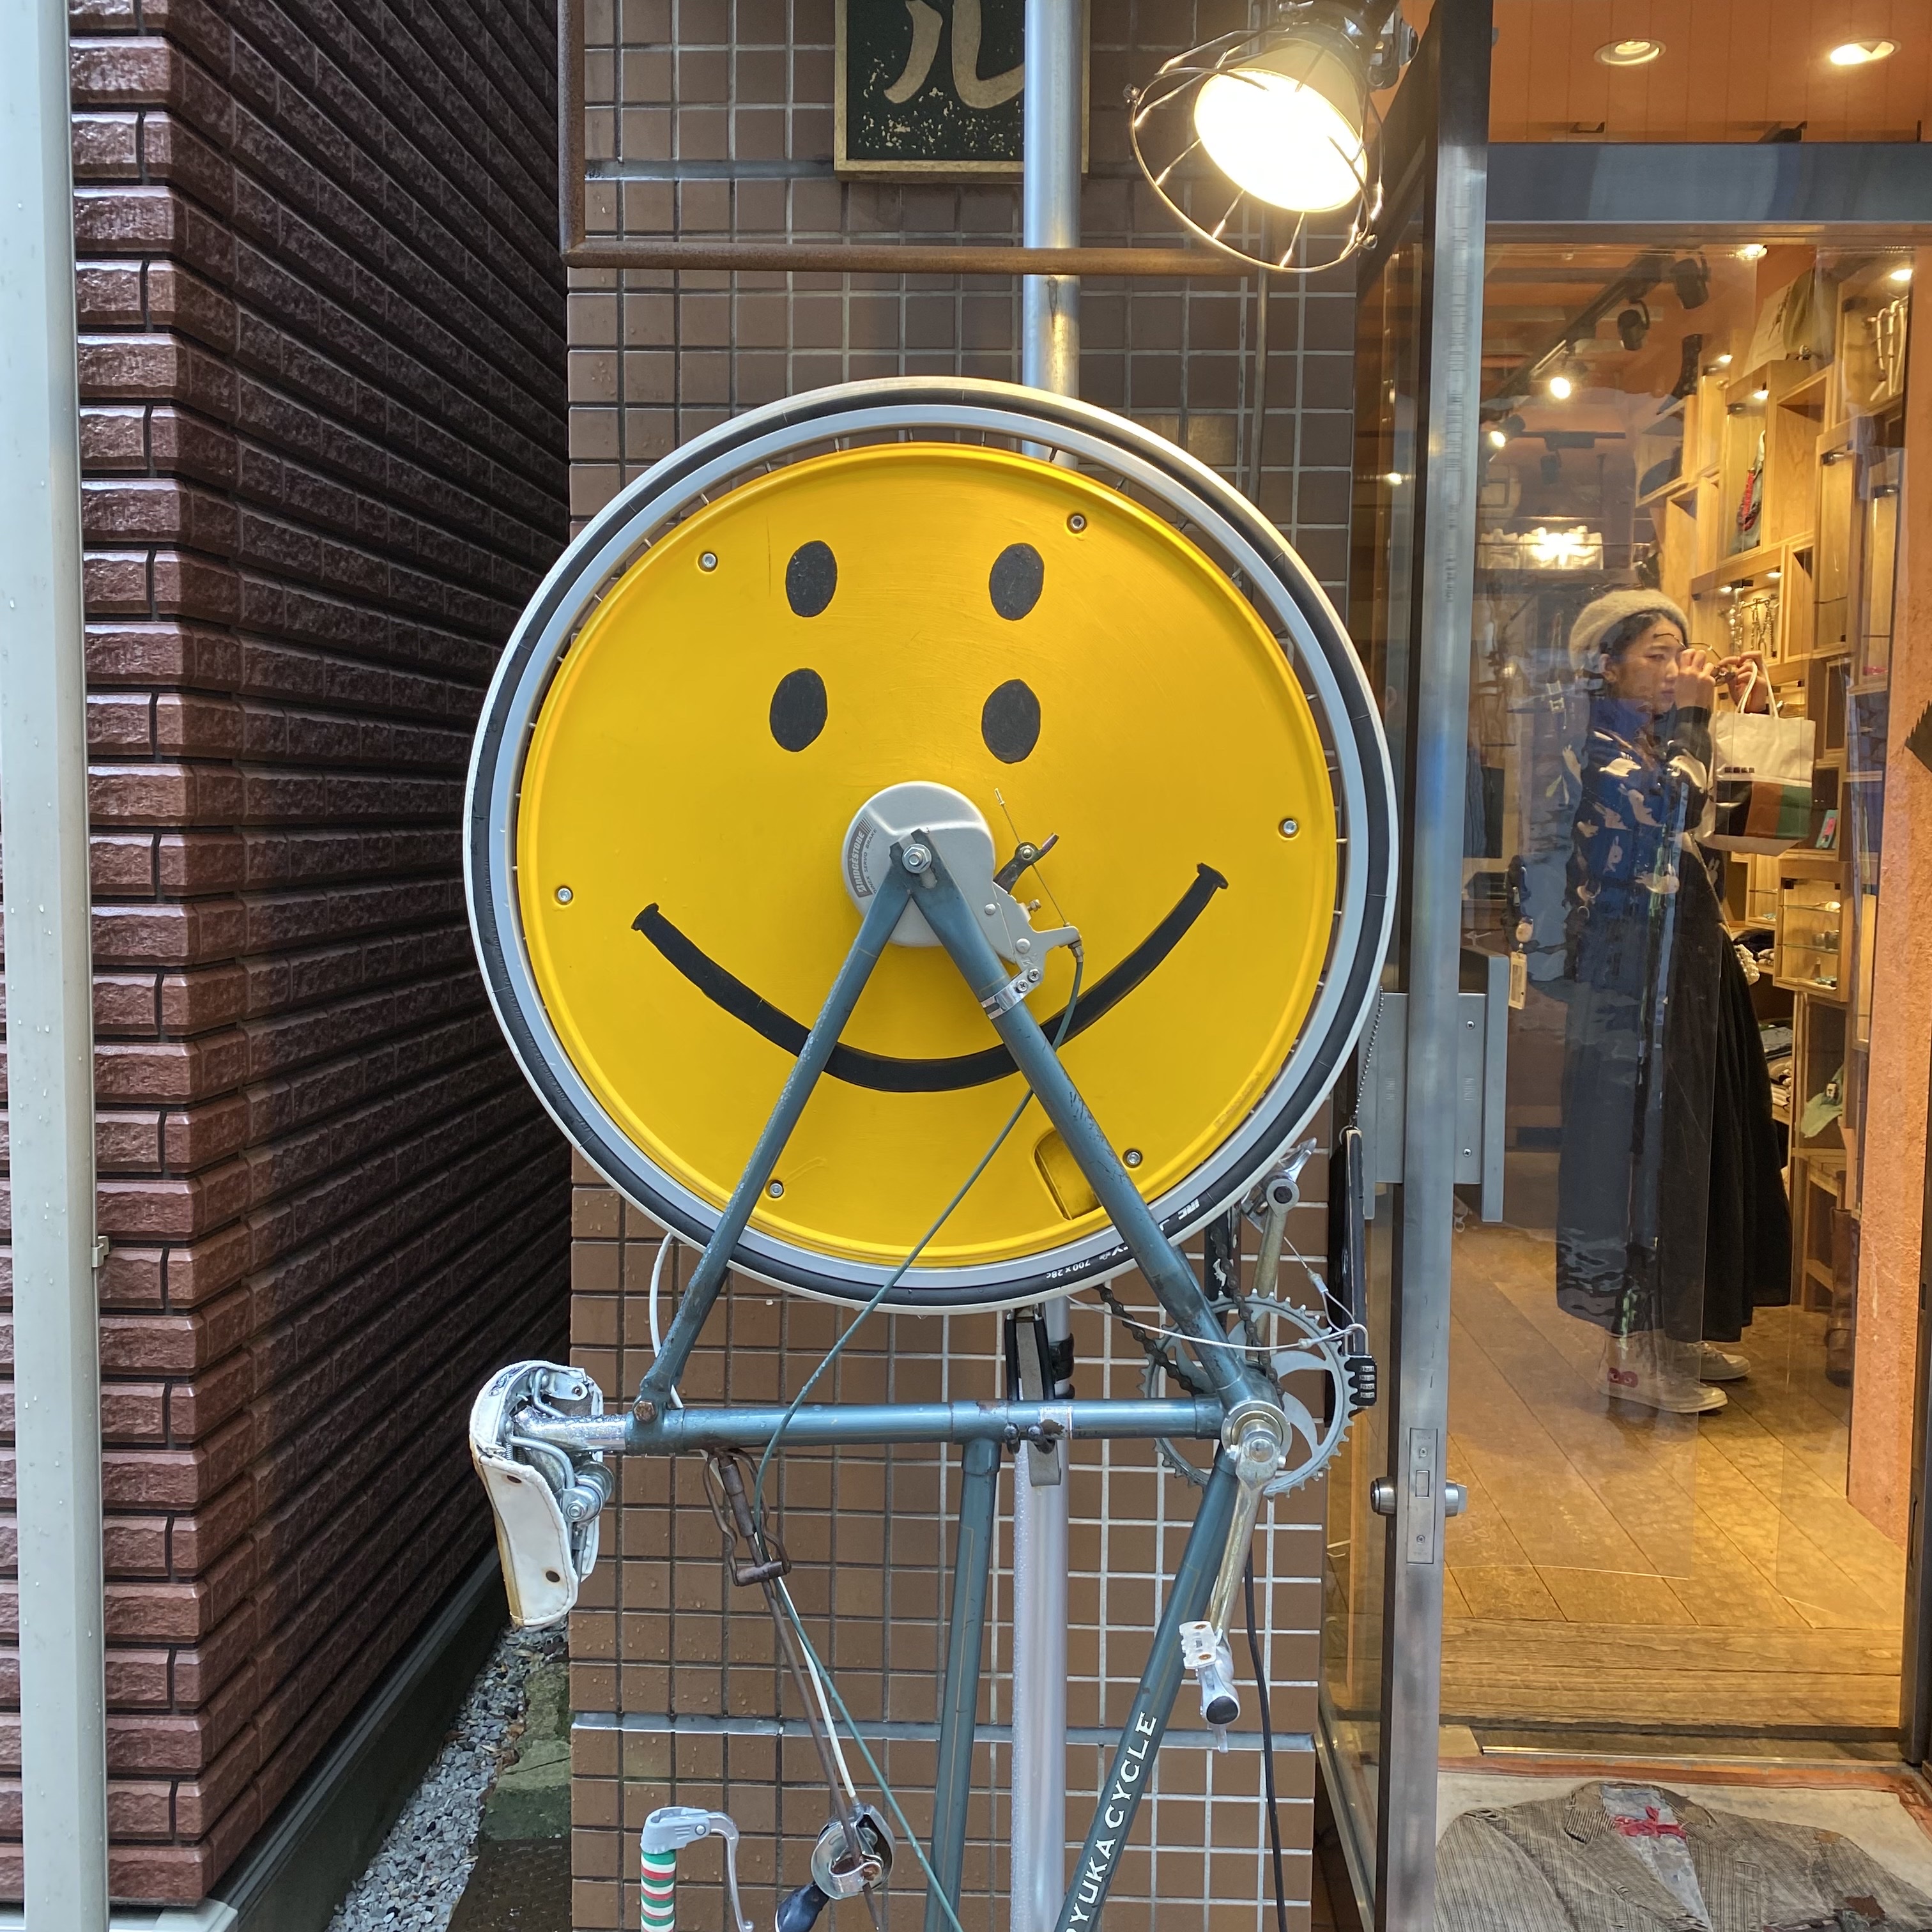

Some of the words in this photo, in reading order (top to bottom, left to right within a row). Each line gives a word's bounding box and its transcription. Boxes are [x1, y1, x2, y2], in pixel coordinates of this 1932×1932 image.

[865, 828, 877, 848] BRAKE
[852, 831, 868, 893] BRIDGESTONE
[1177, 1199, 1200, 1220] IRC
[1046, 1269, 1063, 1278] 28c
[1073, 1259, 1091, 1271] 700
[1066, 1838, 1116, 1932] YUKA
[1105, 1711, 1158, 1828] CYCLE
